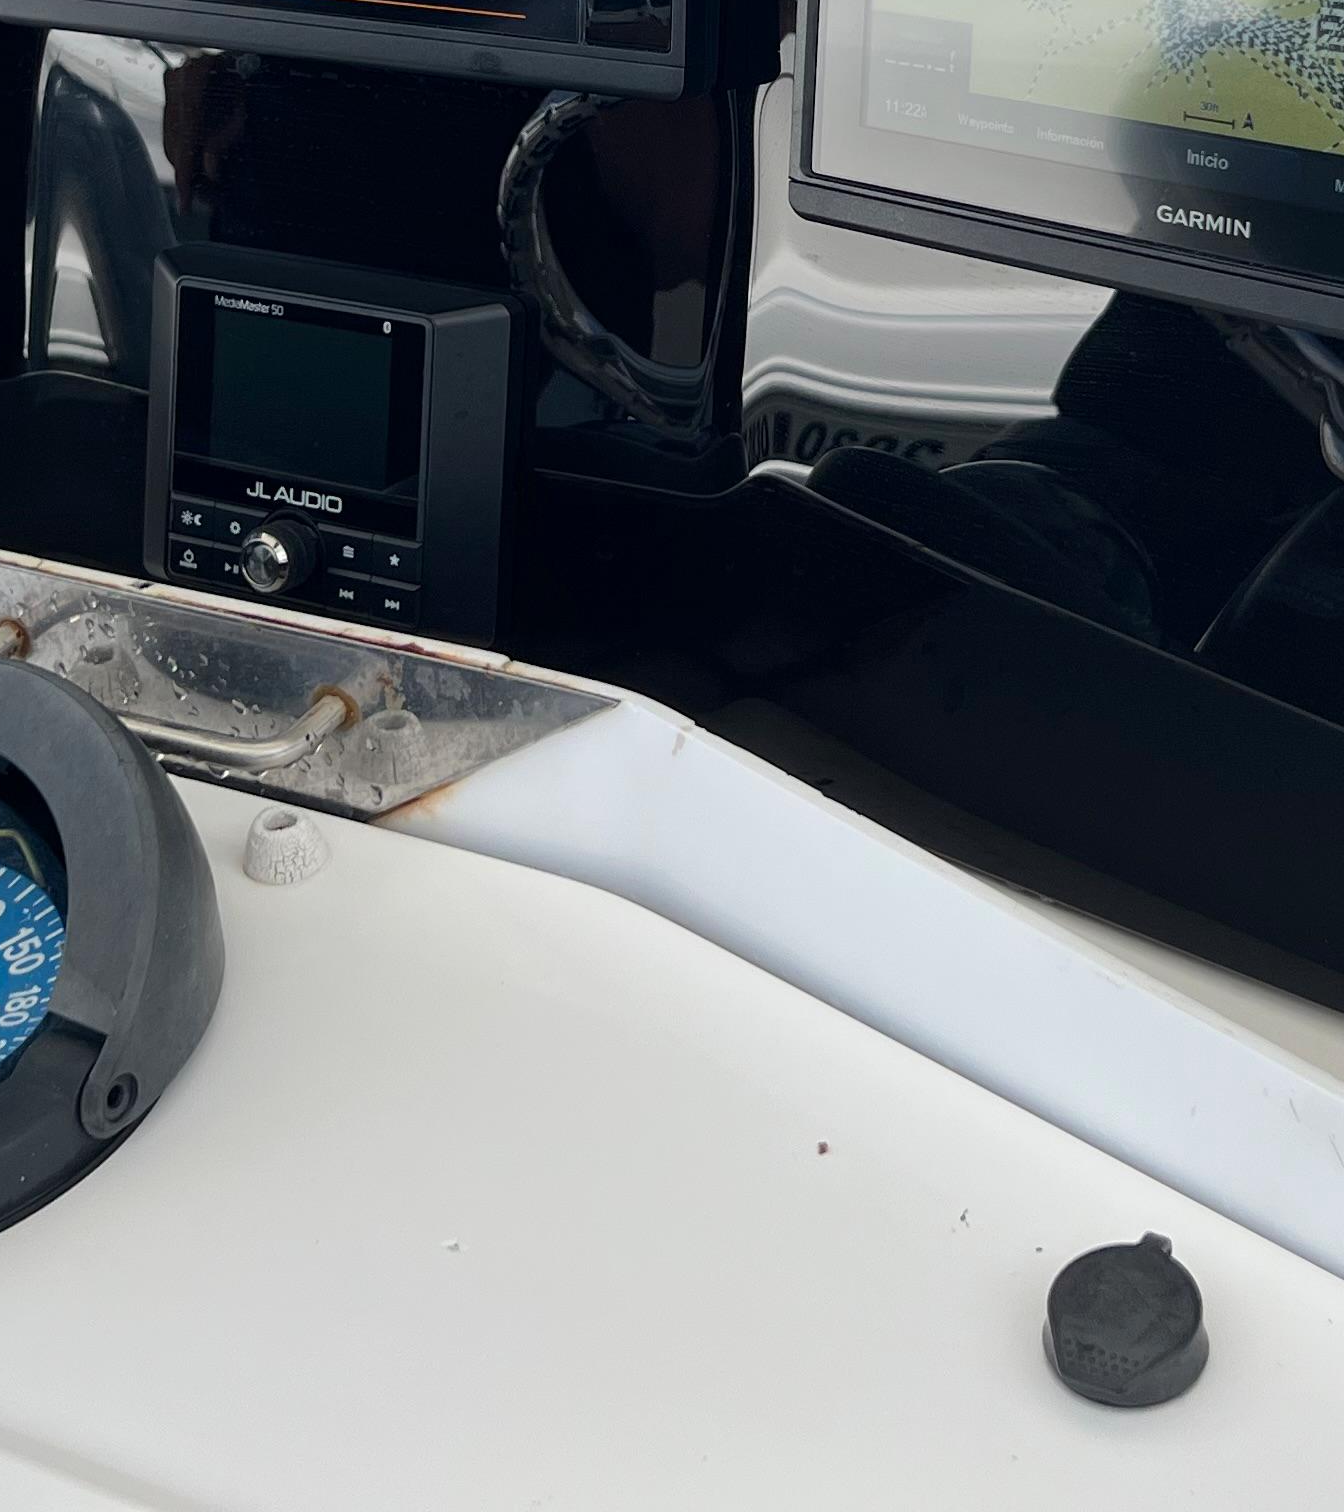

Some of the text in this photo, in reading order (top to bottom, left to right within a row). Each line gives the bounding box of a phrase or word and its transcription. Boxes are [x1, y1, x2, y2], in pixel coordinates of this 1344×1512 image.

[958, 113, 1015, 134] Waypoints
[1037, 127, 1104, 150] Información
[1187, 149, 1229, 170] Inicio
[1156, 204, 1252, 239] GARMIN
[215, 295, 284, 316] MediaMaster 50
[246, 481, 342, 513] JL AUDIO
